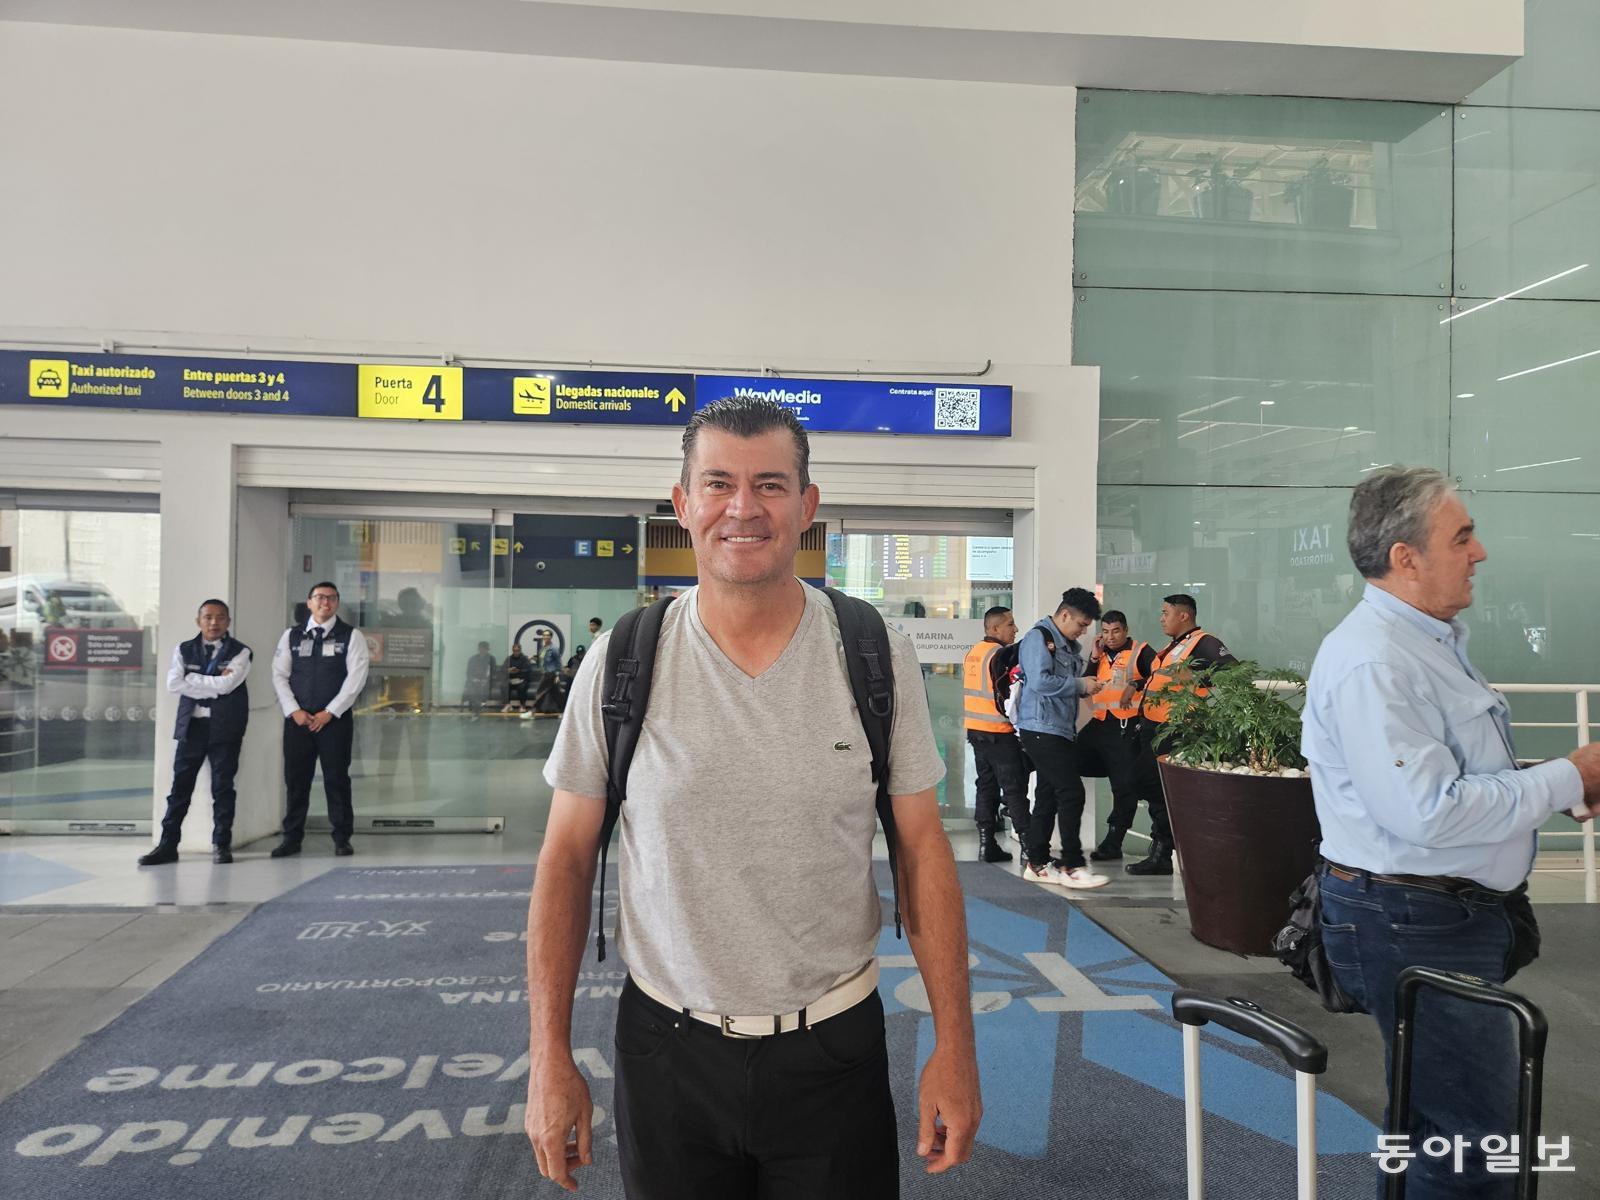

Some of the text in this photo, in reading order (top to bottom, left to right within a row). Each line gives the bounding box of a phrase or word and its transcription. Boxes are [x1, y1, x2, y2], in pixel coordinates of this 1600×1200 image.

[70, 364, 156, 379] Taxi autorizado
[183, 369, 285, 386] Entre puertas 3 y 4
[70, 383, 142, 396] Authorized taxi
[375, 376, 413, 390] Puerta
[183, 386, 290, 402] Between doors 3 and 4
[375, 392, 399, 405] Door
[421, 374, 446, 413] 4
[555, 384, 659, 400] Llegadas nacionales
[889, 388, 918, 396] Contrata
[556, 398, 632, 412] Domestic arrivals
[578, 542, 589, 555] E
[916, 632, 954, 641] MARINA
[296, 919, 432, 942] 欢迎
[255, 975, 516, 995] AEROPORTUARIO
[437, 986, 623, 1005] MINA
